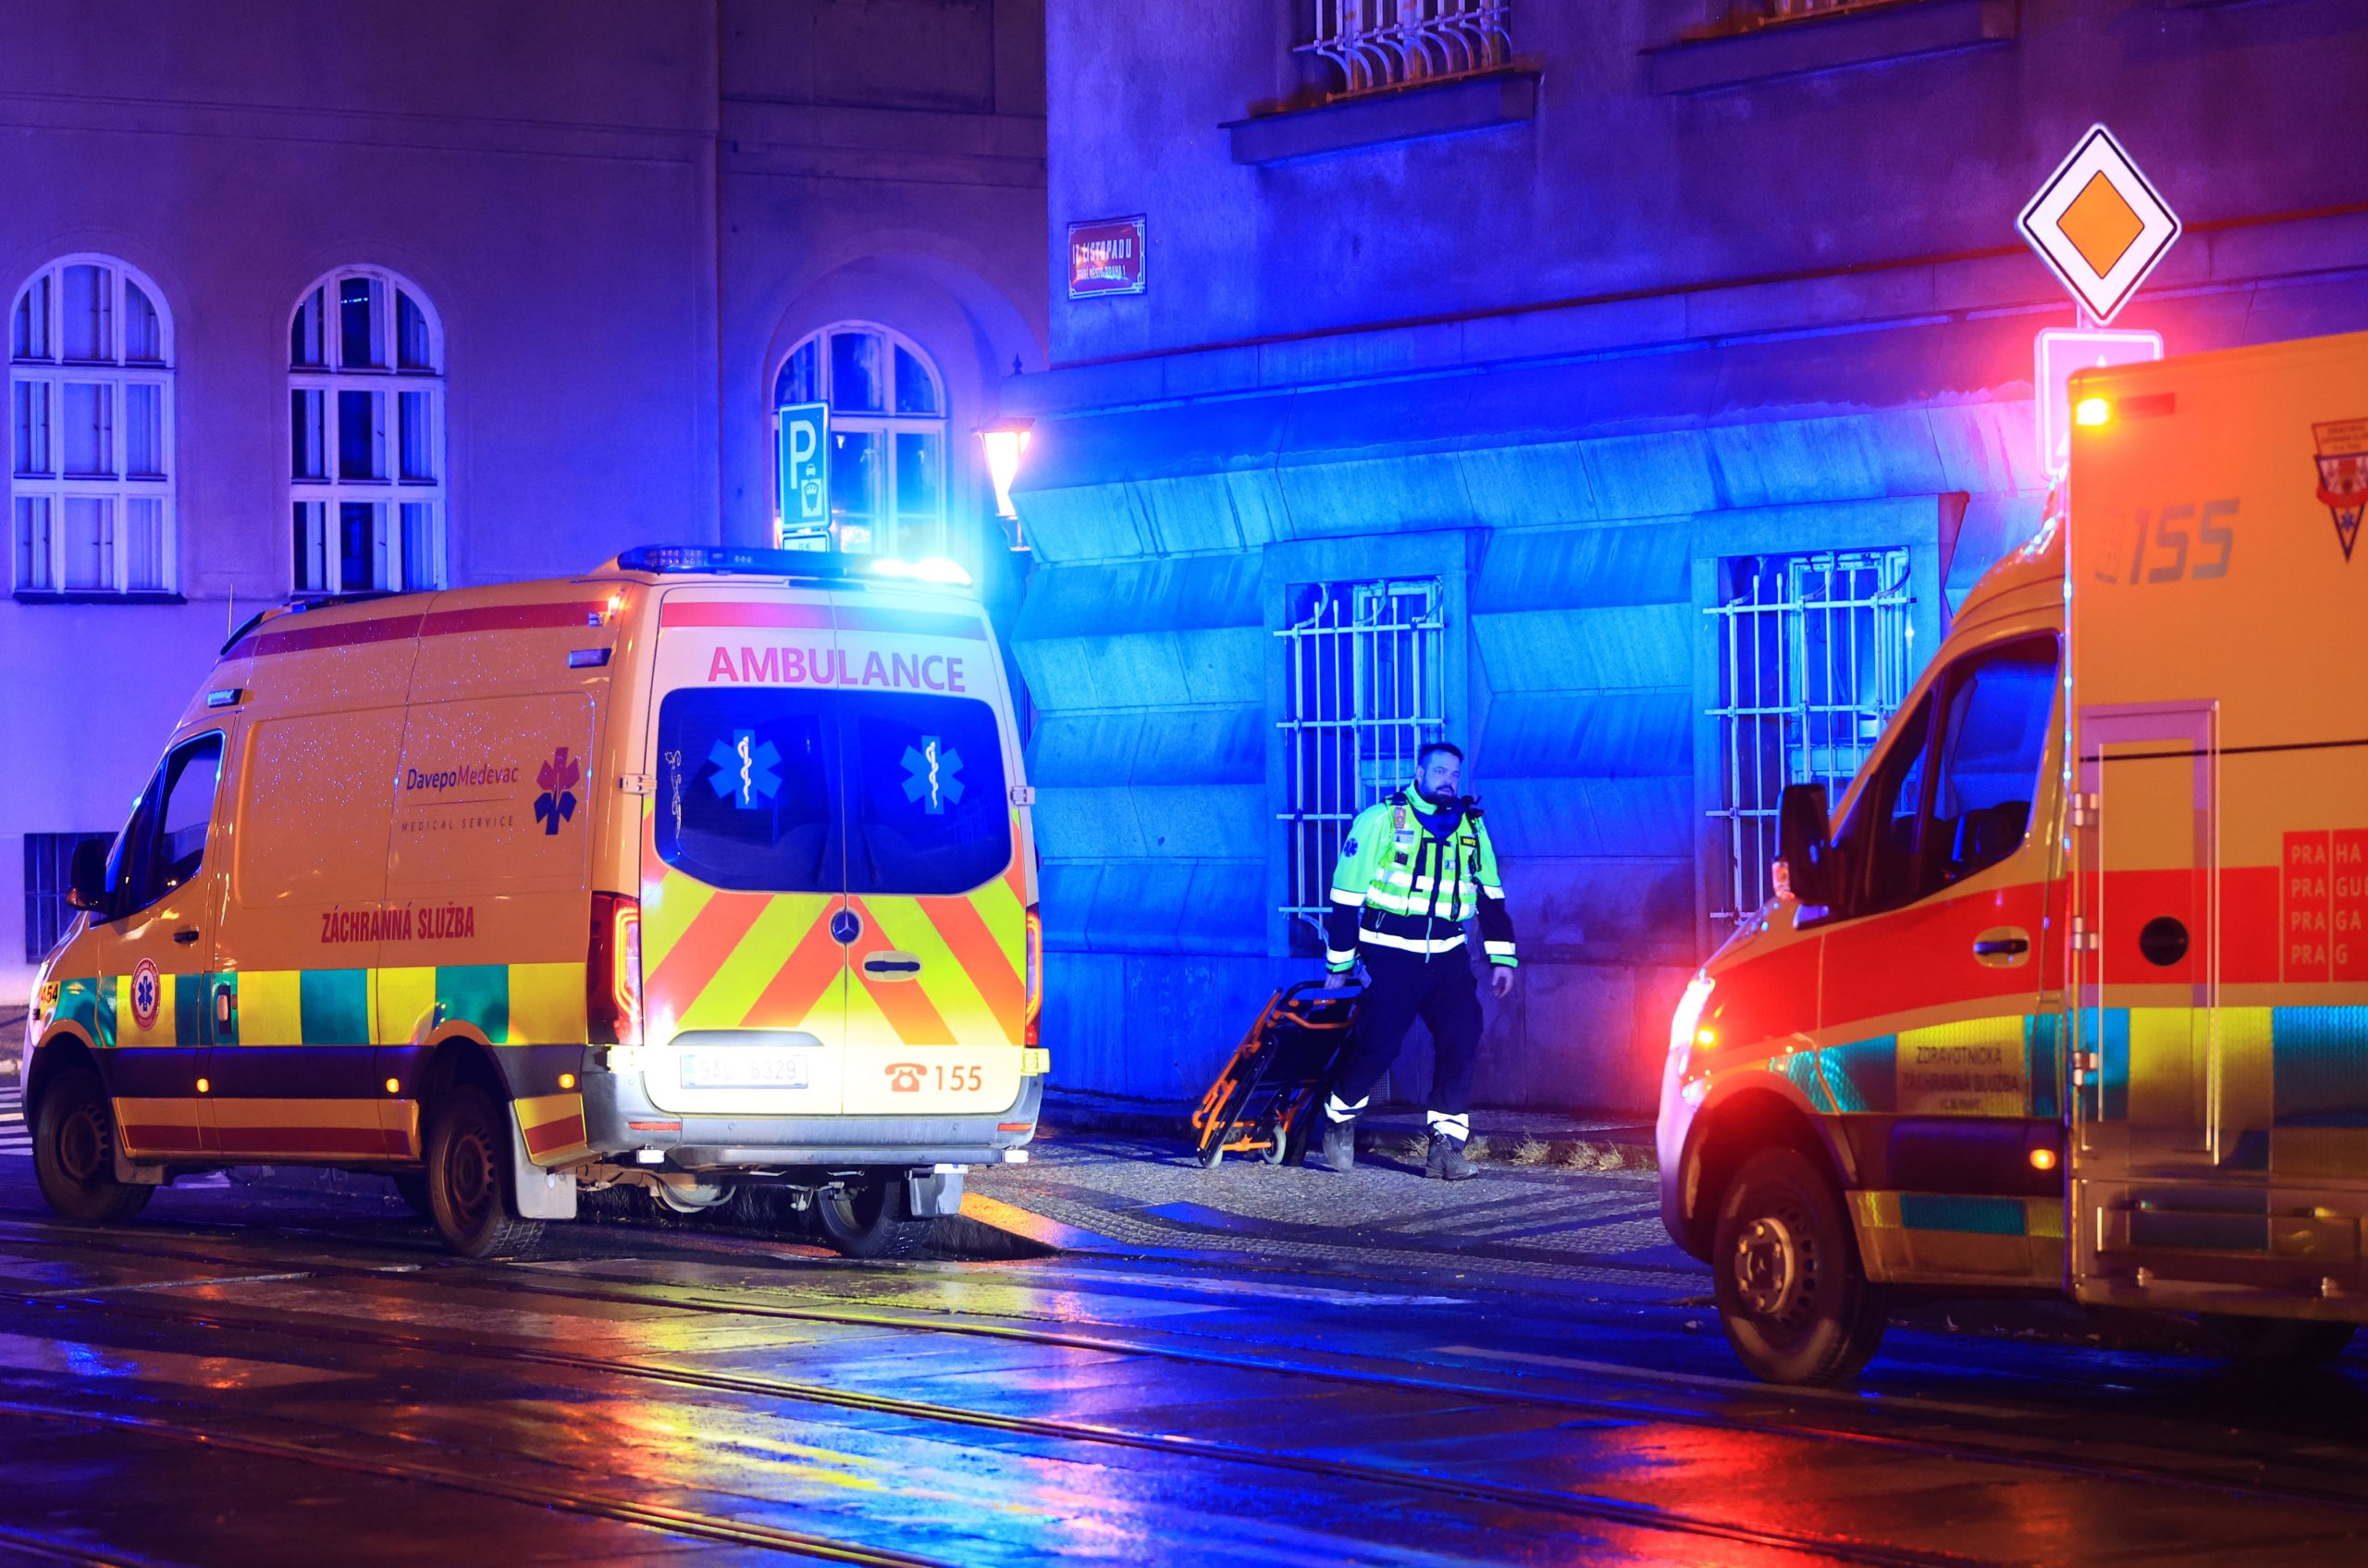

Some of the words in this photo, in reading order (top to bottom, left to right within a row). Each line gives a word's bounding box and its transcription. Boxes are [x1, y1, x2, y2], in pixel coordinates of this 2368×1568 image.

[1083, 238, 1132, 264] LISTOPADU
[790, 420, 817, 489] P
[2130, 497, 2240, 586] 155
[708, 646, 966, 693] AMBULANCE
[406, 764, 519, 793] DavepoMedevac
[401, 820, 453, 833] MEDICAL
[462, 815, 514, 829] SERVICE
[2291, 844, 2325, 864] PRA
[2336, 843, 2362, 863] HA
[2291, 878, 2325, 898] PRA
[321, 902, 412, 944] ZÁCHRANNÁ
[418, 901, 475, 940] SLUŽBA
[2291, 910, 2325, 932] PRA
[2336, 909, 2362, 931] GA
[2291, 945, 2325, 965] PRA
[2336, 944, 2349, 964] G
[750, 1059, 797, 1080] 8329
[934, 1065, 982, 1092] 155
